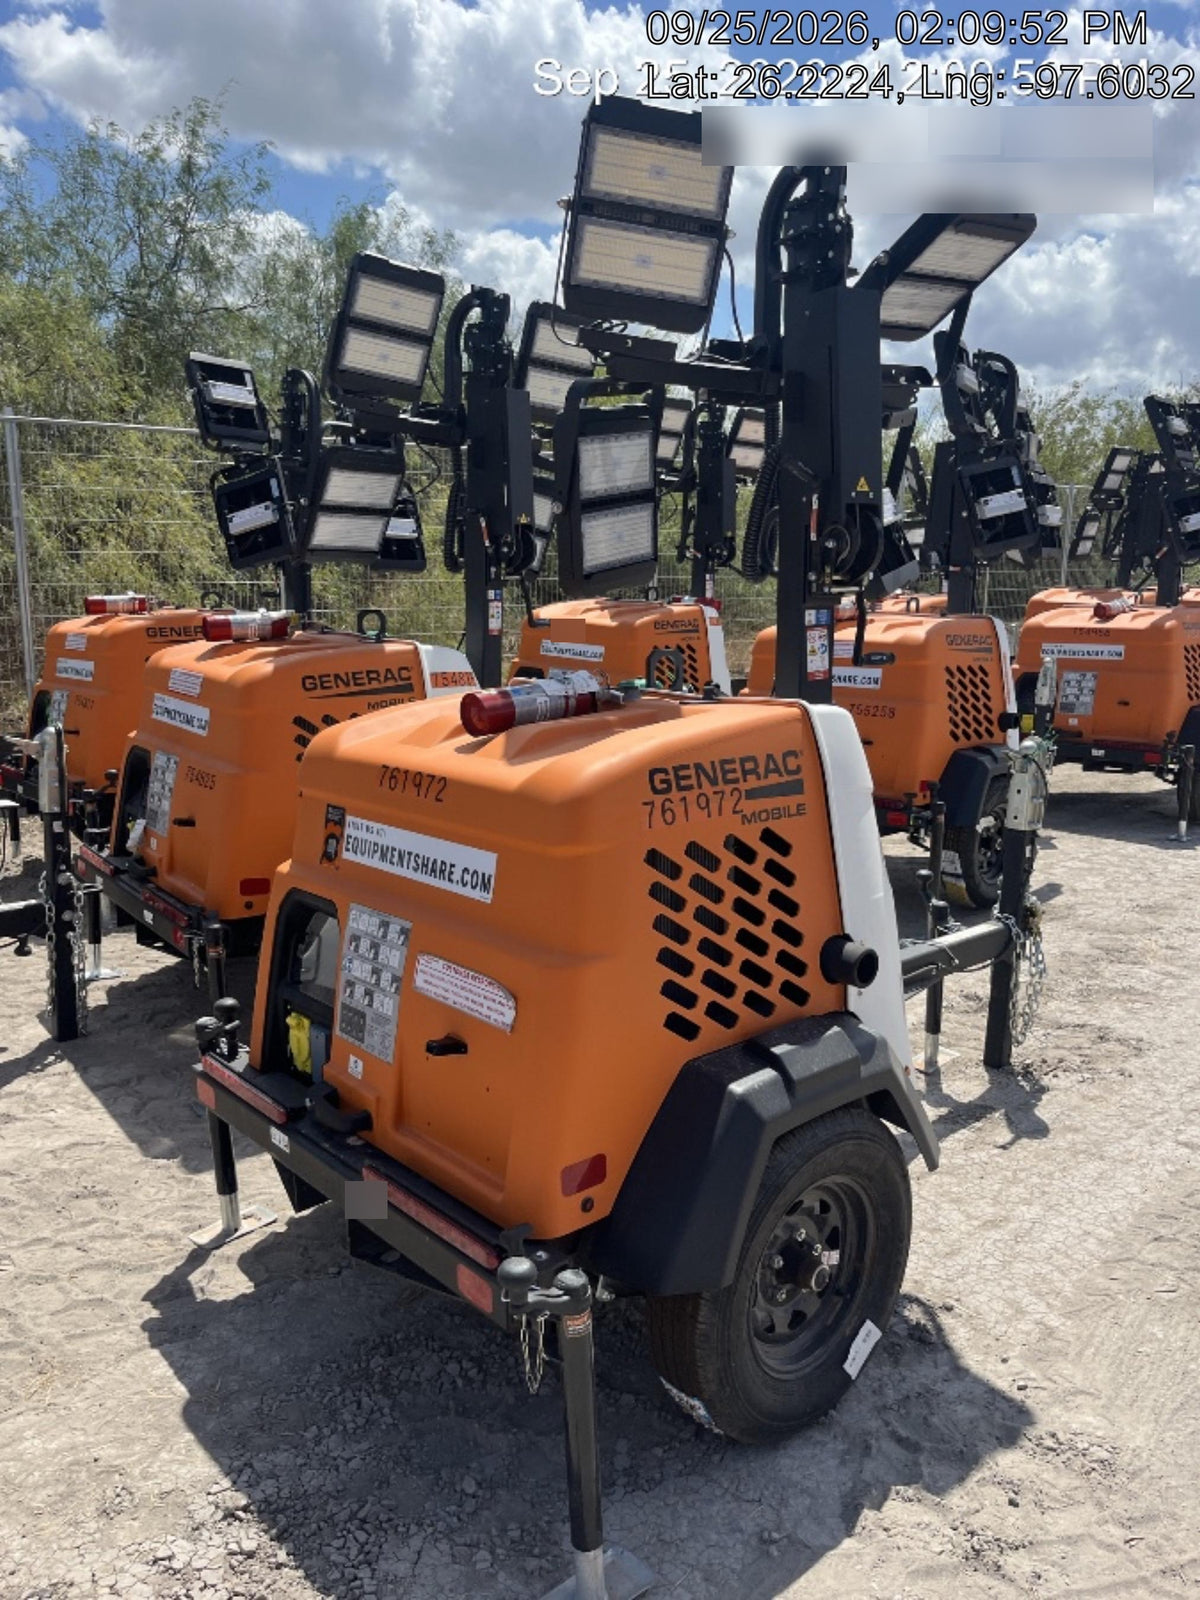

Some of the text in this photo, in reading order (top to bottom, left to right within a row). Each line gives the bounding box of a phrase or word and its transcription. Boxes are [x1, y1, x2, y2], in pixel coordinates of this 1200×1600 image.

[146, 625, 204, 638] GENER
[301, 666, 412, 692] GENERAC
[379, 764, 448, 802] 761972
[648, 750, 802, 795] GENERAC
[642, 787, 743, 829] 761972
[741, 802, 807, 825] MOBILE
[344, 834, 493, 895] EQUIPMENTSHARE.COM
